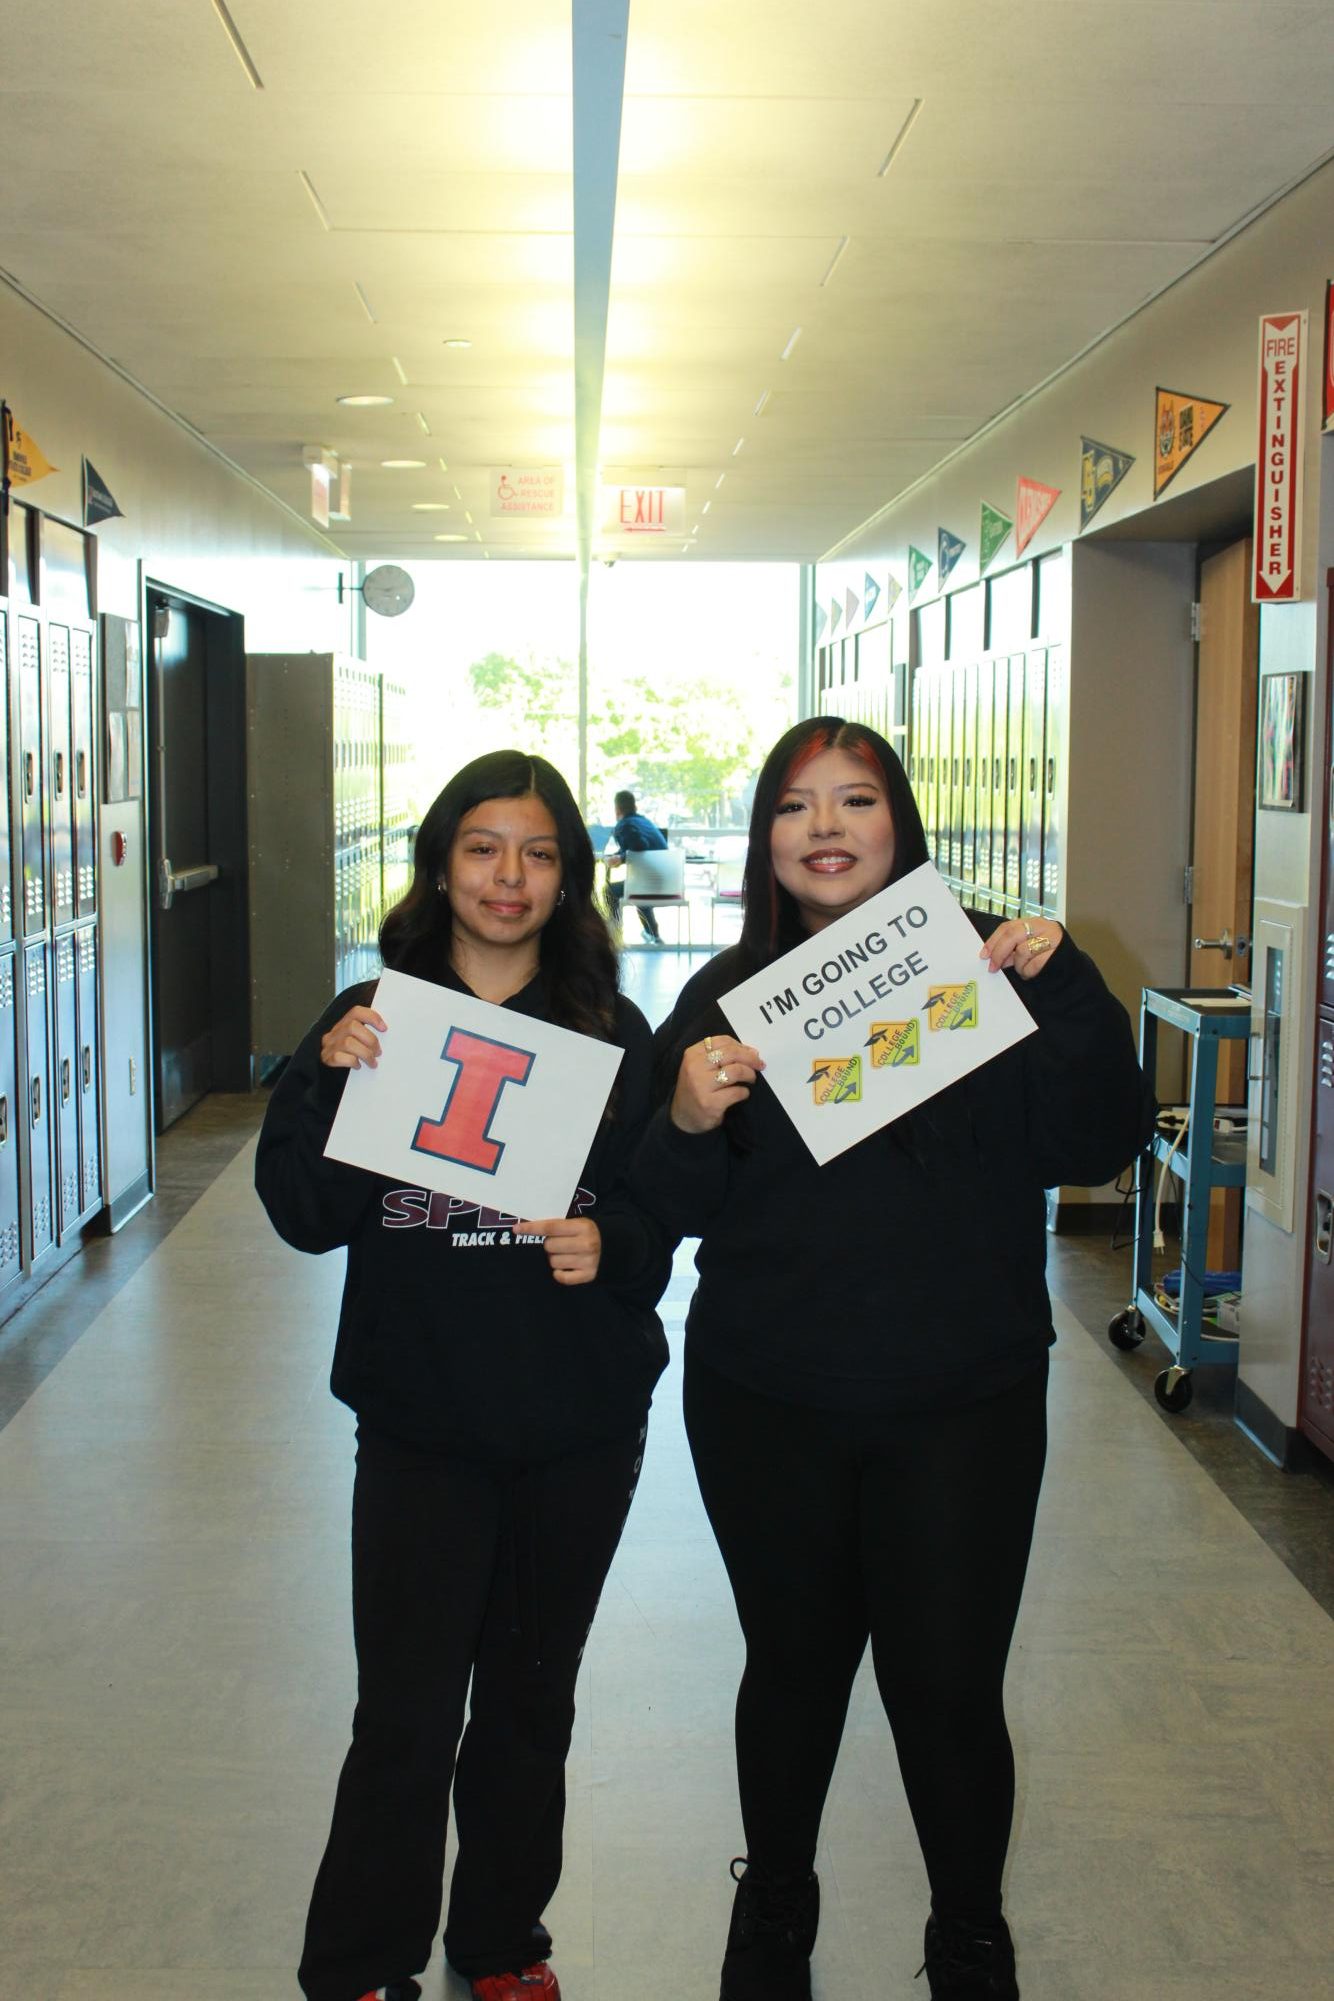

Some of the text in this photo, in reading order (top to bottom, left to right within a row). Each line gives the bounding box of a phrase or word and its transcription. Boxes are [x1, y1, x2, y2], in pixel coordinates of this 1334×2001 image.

[1266, 337, 1296, 357] FIRE
[518, 476, 541, 485] AREA
[1269, 360, 1286, 575] EXTINGUISHER
[501, 502, 554, 511] ASSISTANCE
[520, 489, 554, 497] RESCUE
[620, 489, 666, 524] EXIT
[759, 904, 929, 1024] I'M GOING TO
[803, 950, 929, 1041] COLLEGE
[936, 992, 960, 1029] COLLEGE
[953, 984, 973, 1013] BOUND
[878, 1029, 902, 1066] COLLEGE
[895, 1021, 916, 1050] BOUND
[820, 1066, 845, 1102] COLLEGE
[837, 1057, 858, 1087] BOUND
[410, 1025, 536, 1176] I
[451, 1231, 546, 1247] TRACK & FIEL
